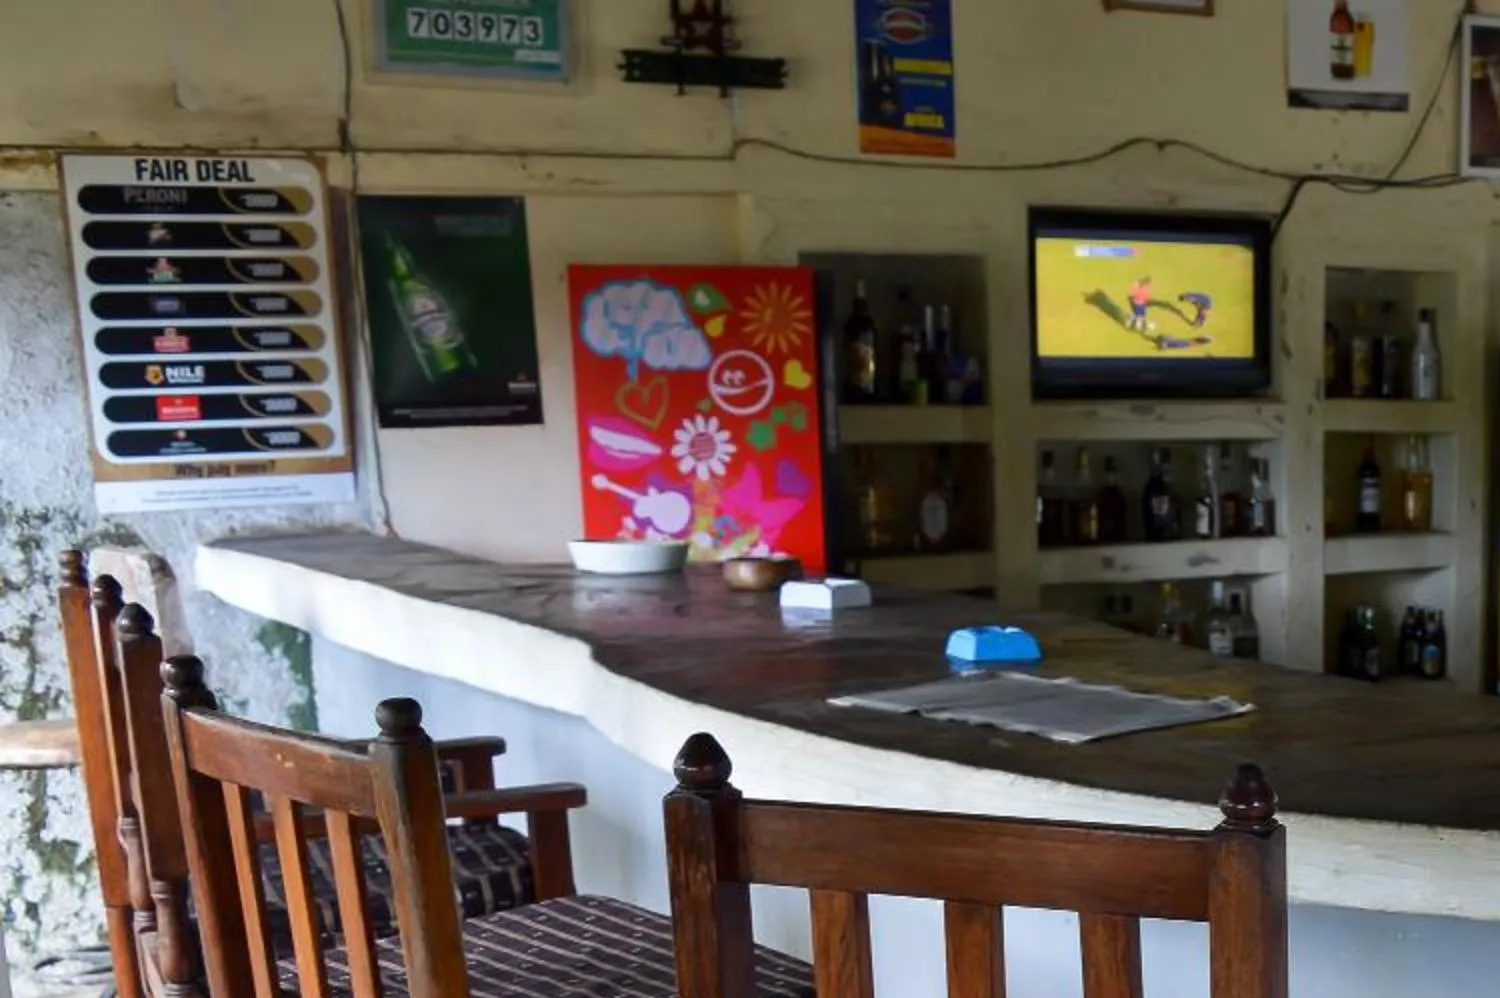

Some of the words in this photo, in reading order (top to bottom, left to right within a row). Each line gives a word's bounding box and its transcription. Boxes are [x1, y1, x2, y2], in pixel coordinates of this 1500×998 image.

[409, 11, 540, 43] 703973
[134, 159, 189, 181] FAIR
[196, 160, 255, 182] DEAL
[123, 186, 187, 205] PERONI
[165, 365, 205, 378] NILE
